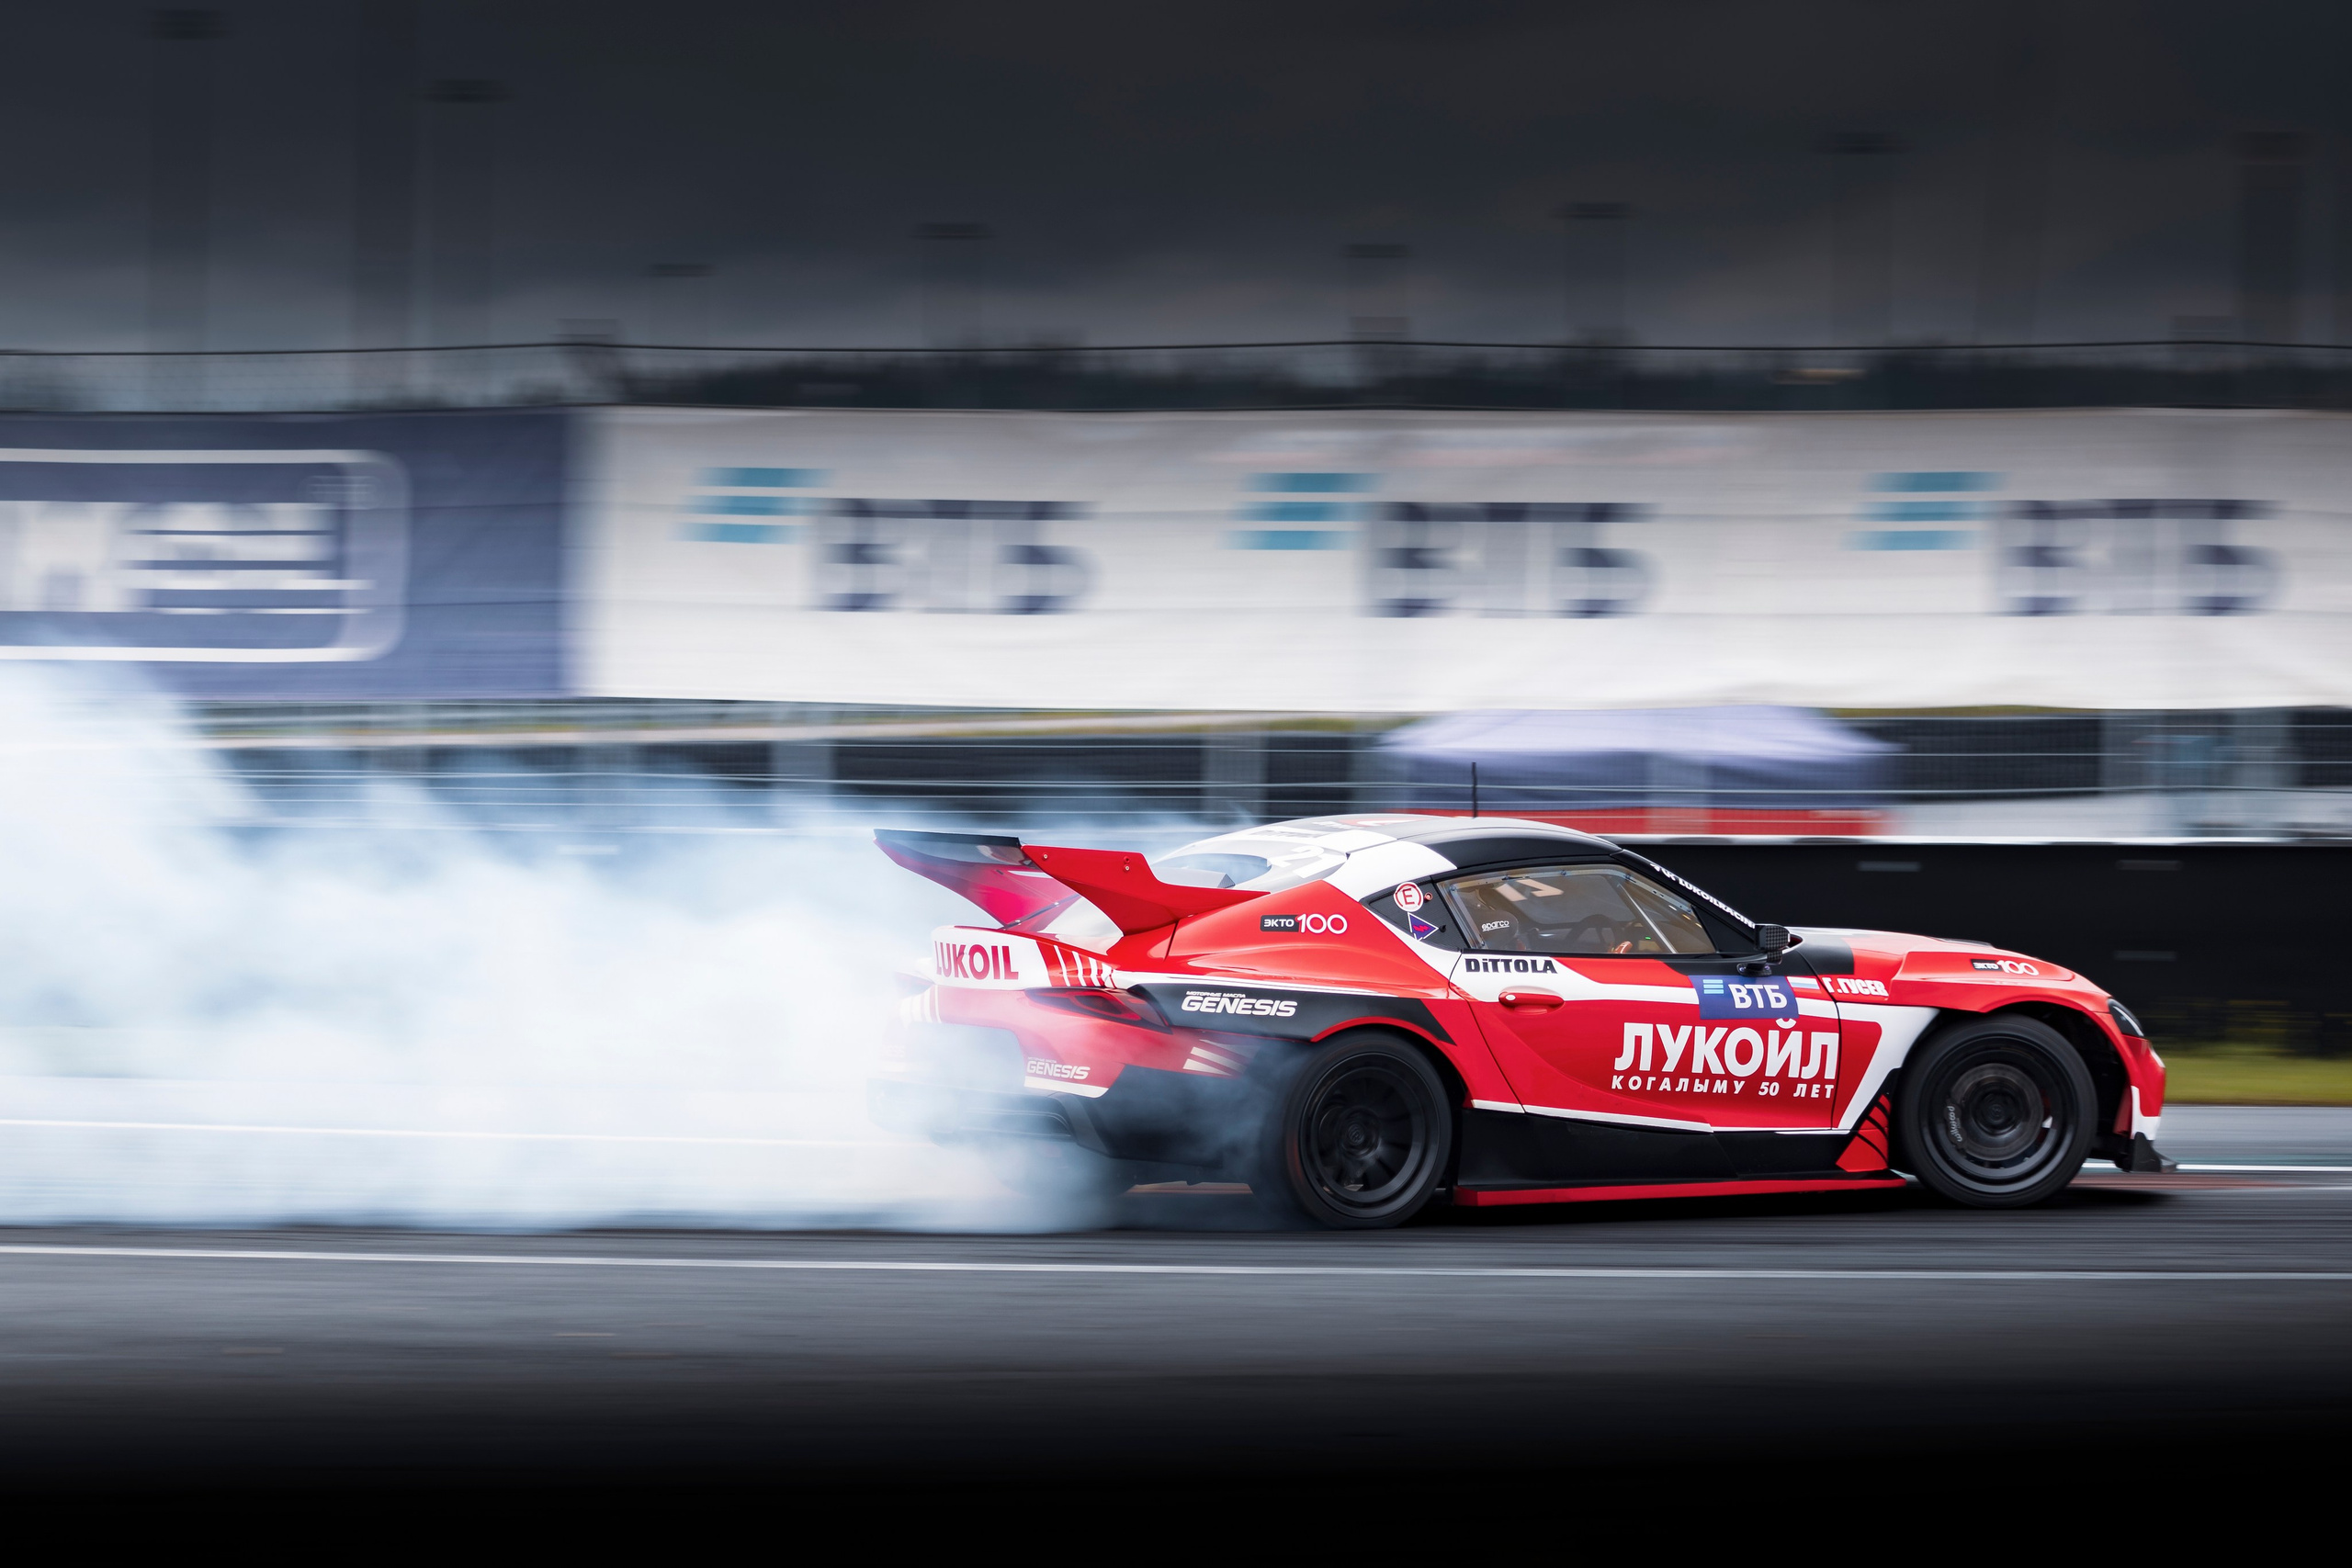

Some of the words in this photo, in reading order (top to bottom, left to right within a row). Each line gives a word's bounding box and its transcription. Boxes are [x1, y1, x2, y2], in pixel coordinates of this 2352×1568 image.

[1402, 887, 1415, 905] E
[1679, 877, 1756, 930] LUKOILRACIN
[1263, 919, 1295, 928] ЭКТО
[1296, 913, 1348, 934] 100
[934, 941, 1019, 980] LUKOIL
[1464, 957, 1558, 974] DiTTOLA
[1996, 959, 2039, 976] 100
[1182, 996, 1298, 1017] GENESIS
[1728, 984, 1788, 1009] ВТБ
[1613, 1018, 1839, 1080] ЛУКОЙЛ
[1026, 1060, 1091, 1080] GENESIS
[1611, 1075, 1746, 1094] КОГАЛЫМУ
[1758, 1081, 1780, 1097] 50
[1792, 1083, 1835, 1099] ЛЕТ
